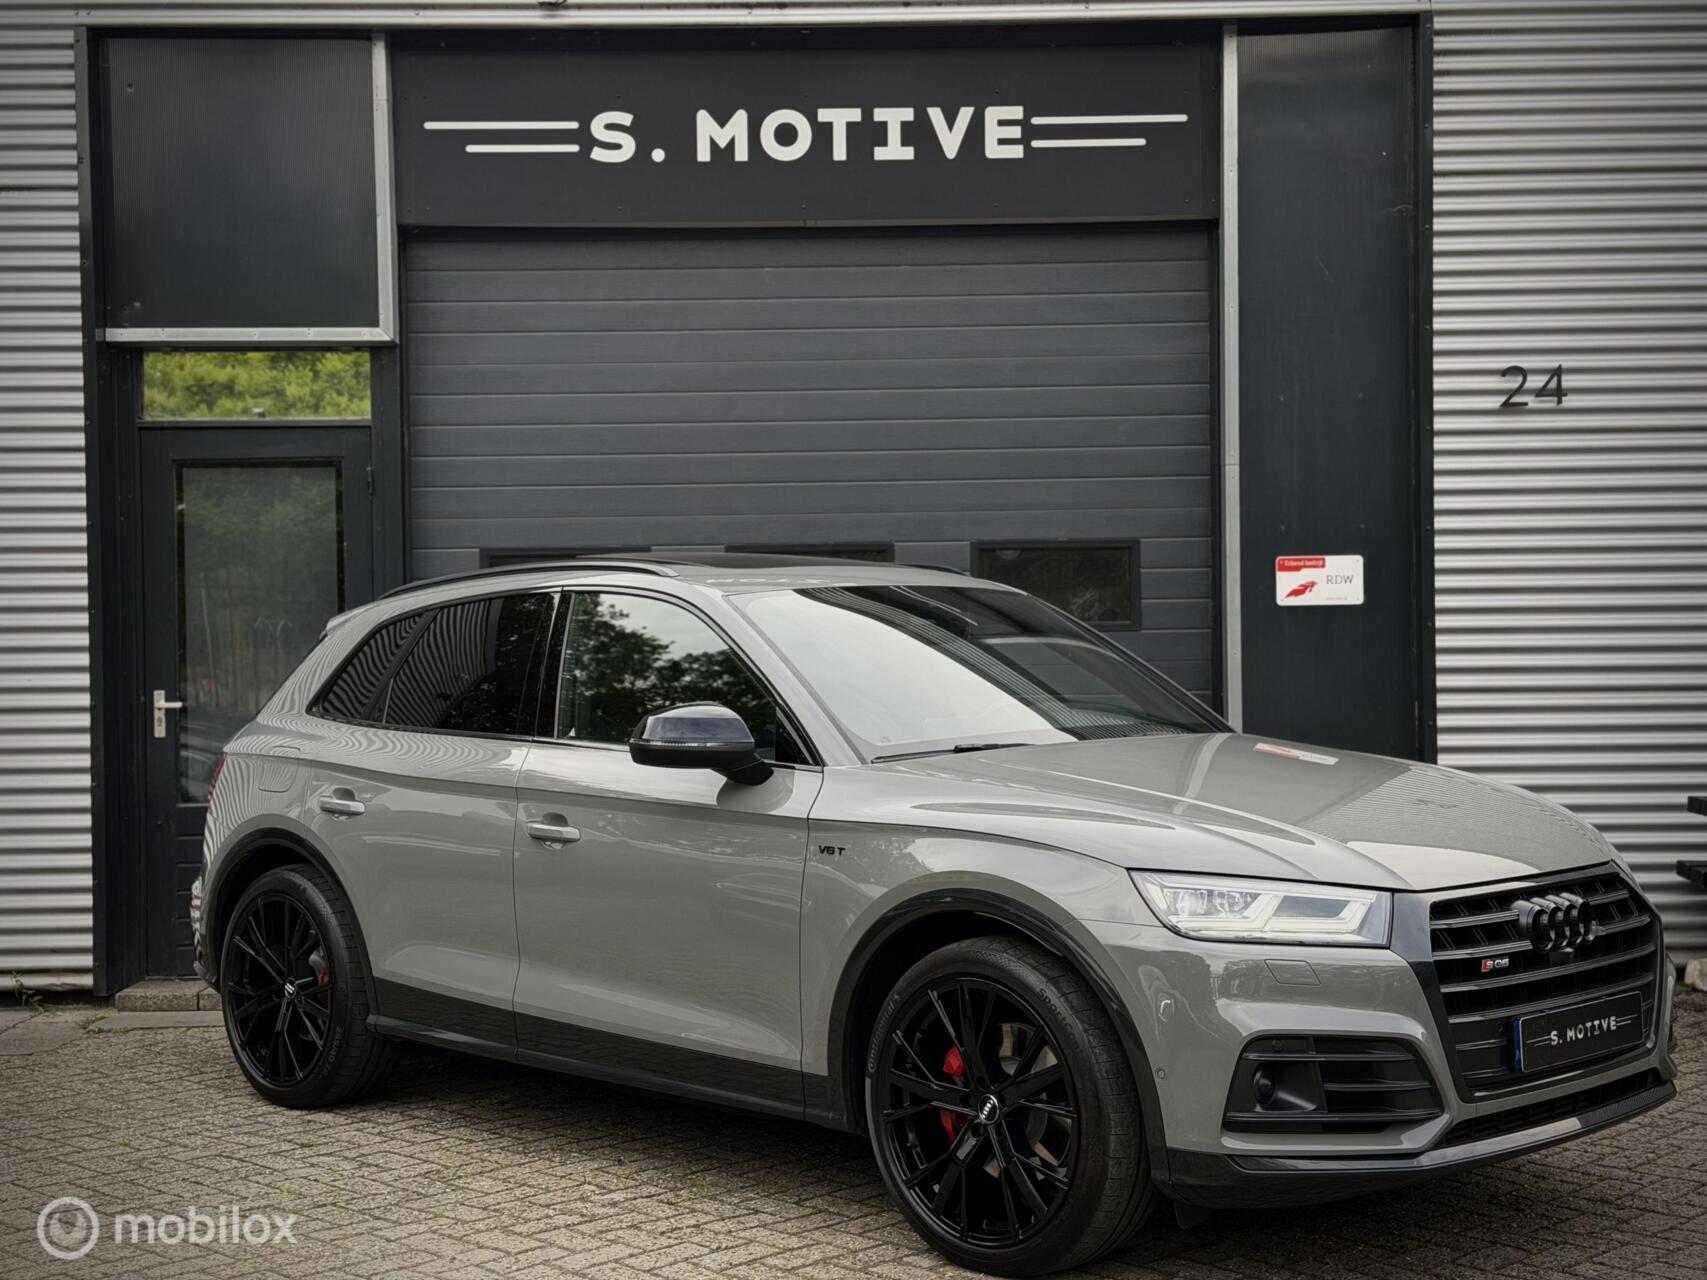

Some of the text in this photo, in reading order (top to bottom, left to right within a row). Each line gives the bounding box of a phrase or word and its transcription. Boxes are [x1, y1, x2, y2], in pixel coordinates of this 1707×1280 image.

[590, 105, 1024, 163] S. MOTIVE
[1499, 364, 1568, 407] 24
[1326, 574, 1354, 585] RDW
[818, 845, 846, 856] V6 T
[1550, 1016, 1617, 1046] S. MOTIVE
